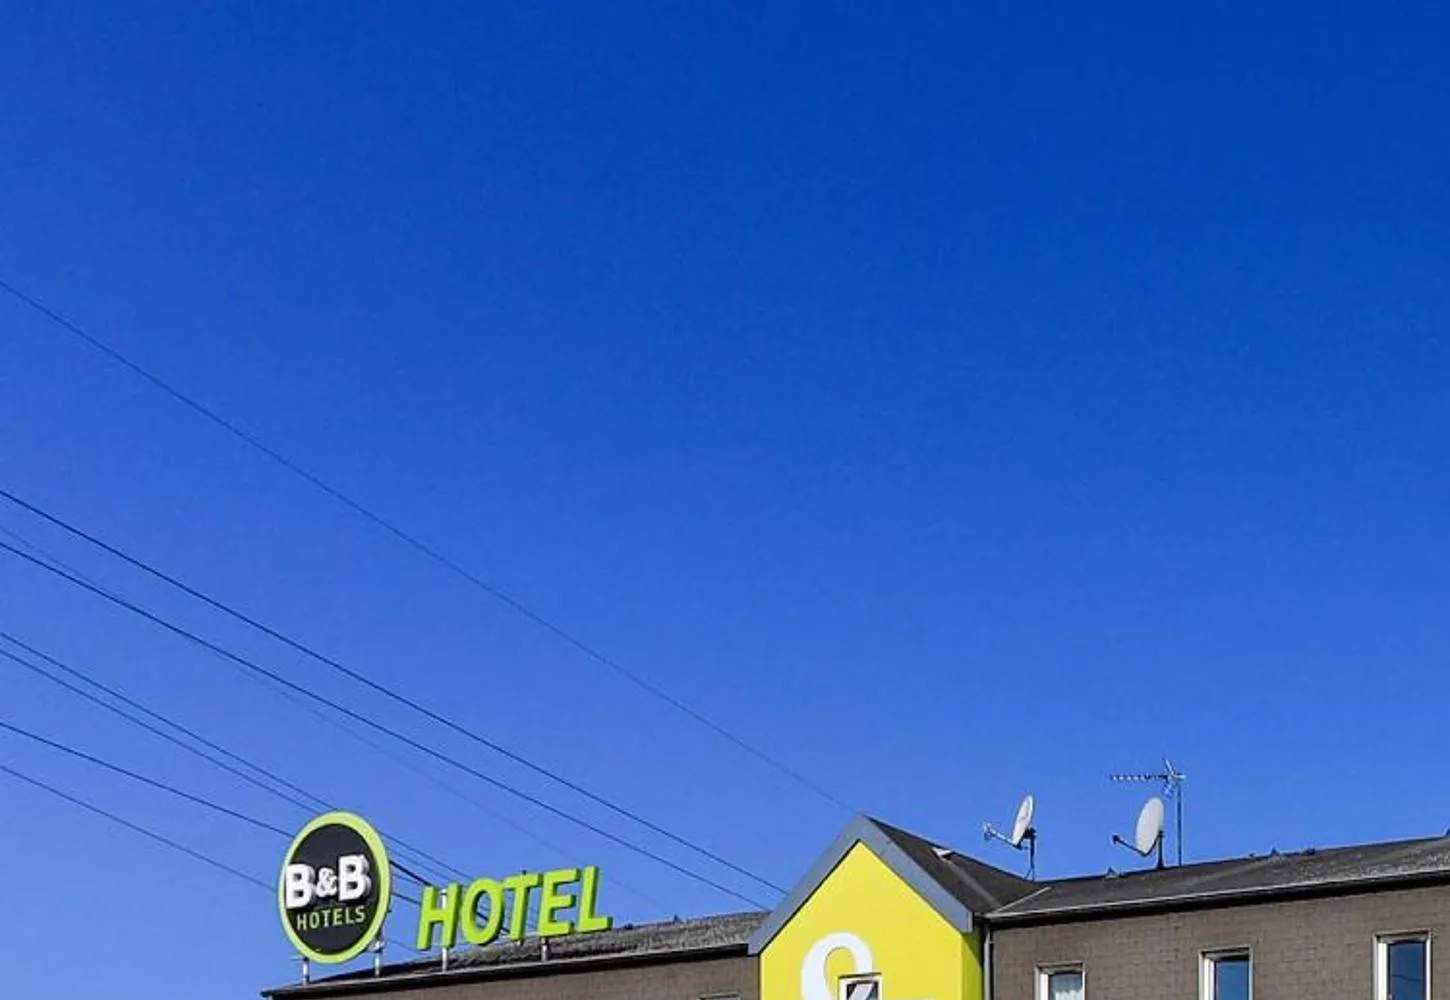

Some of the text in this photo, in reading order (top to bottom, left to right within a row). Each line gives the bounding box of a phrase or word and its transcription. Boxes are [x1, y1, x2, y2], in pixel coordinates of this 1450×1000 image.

[285, 854, 371, 909] B&B
[417, 865, 613, 950] HOTEL
[297, 905, 366, 931] HOTELS
